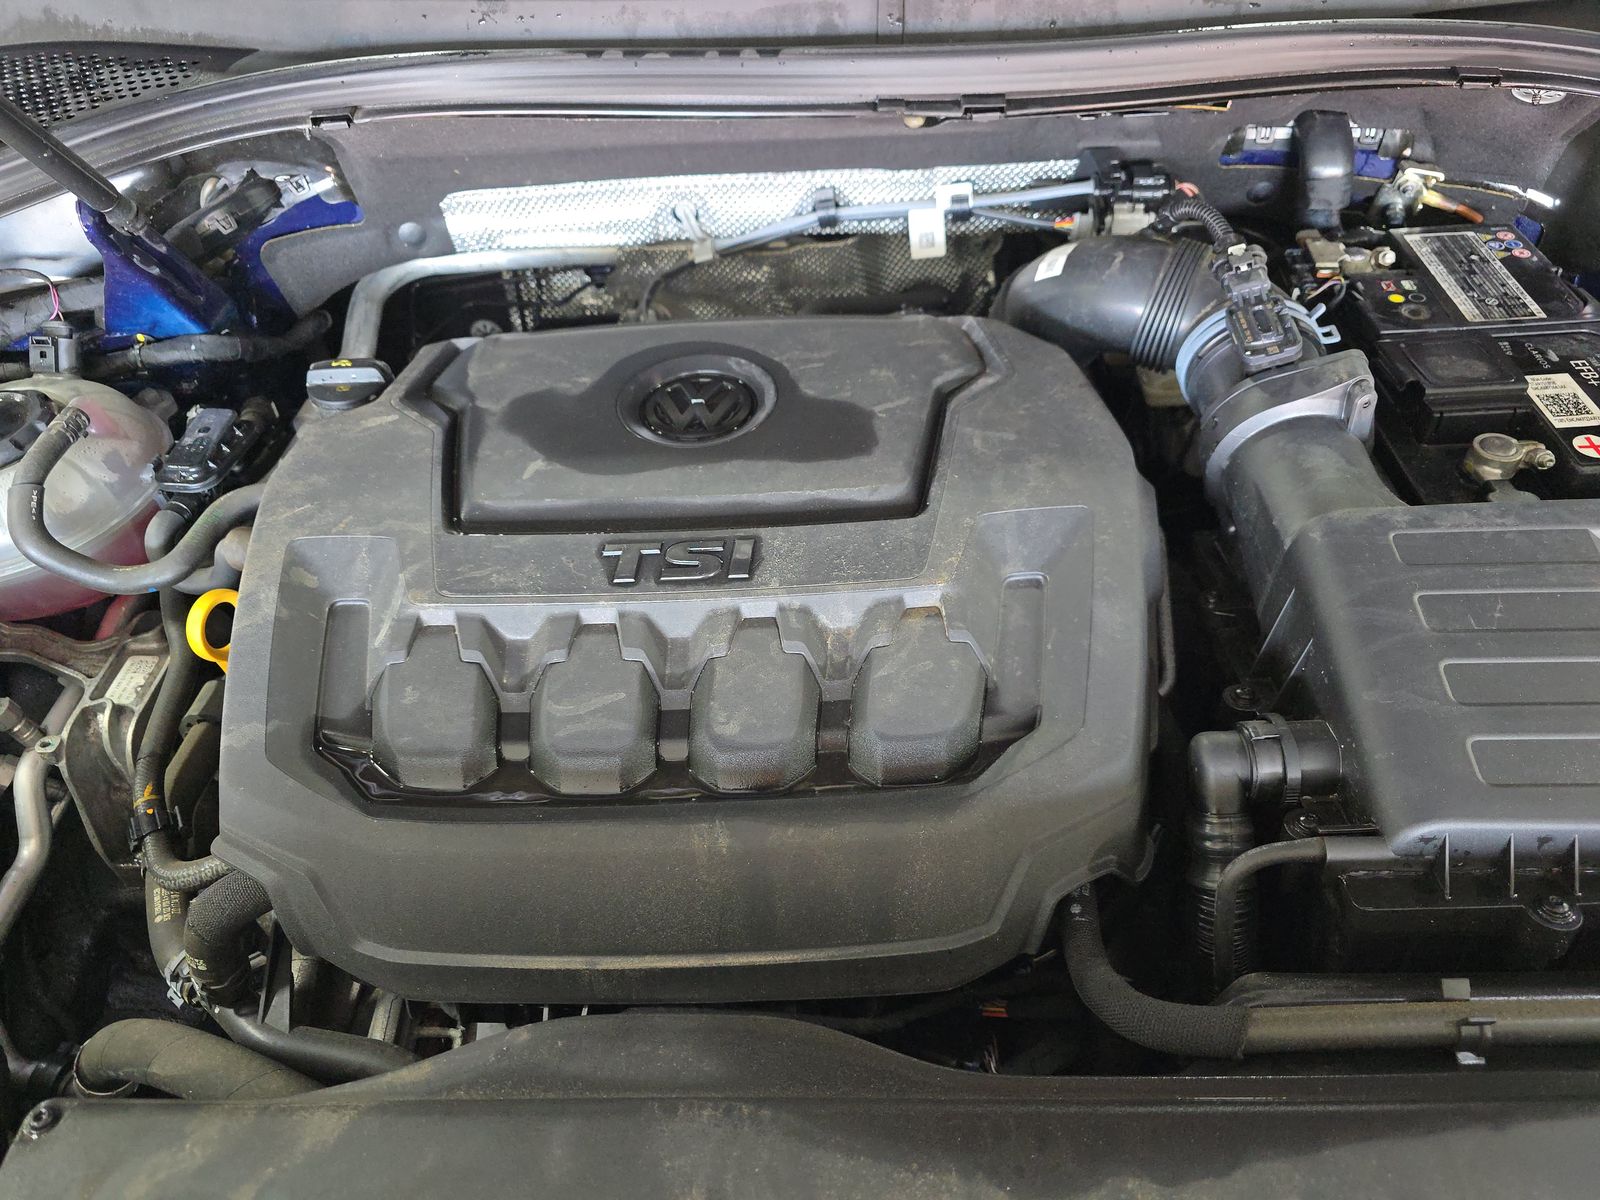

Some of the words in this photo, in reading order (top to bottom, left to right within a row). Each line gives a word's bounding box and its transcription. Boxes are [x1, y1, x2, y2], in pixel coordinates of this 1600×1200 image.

[1525, 342, 1551, 369] CLARIOS
[1569, 360, 1600, 387] EFB+
[651, 376, 750, 436] VW
[602, 537, 755, 584] TSI
